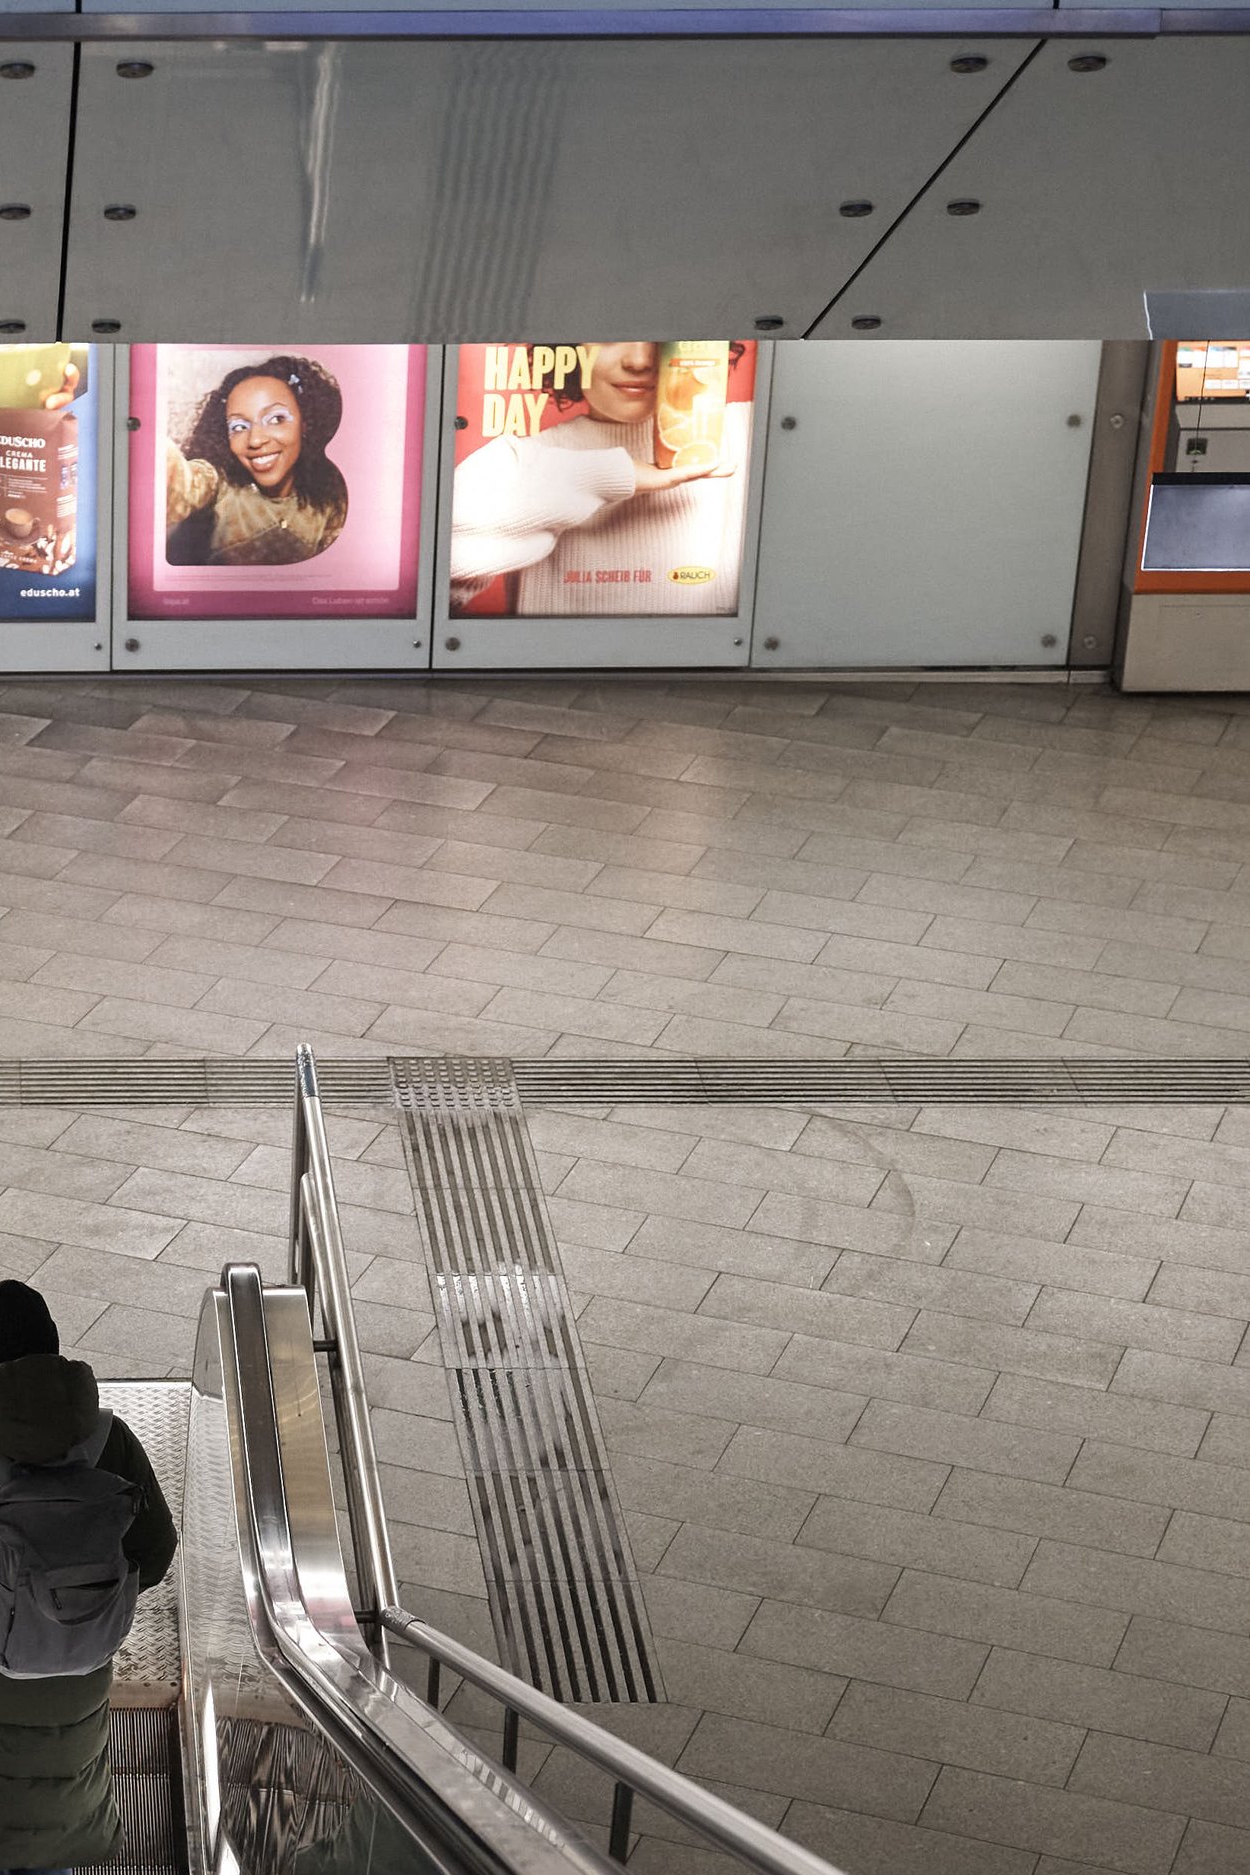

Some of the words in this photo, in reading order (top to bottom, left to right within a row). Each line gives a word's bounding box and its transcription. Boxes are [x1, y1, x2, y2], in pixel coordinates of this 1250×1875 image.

[484, 345, 602, 390] HAPPY
[482, 393, 549, 437] DAY
[6, 450, 33, 458] CREMA
[680, 571, 711, 580] RAUCH
[20, 588, 80, 597] eduscho.at
